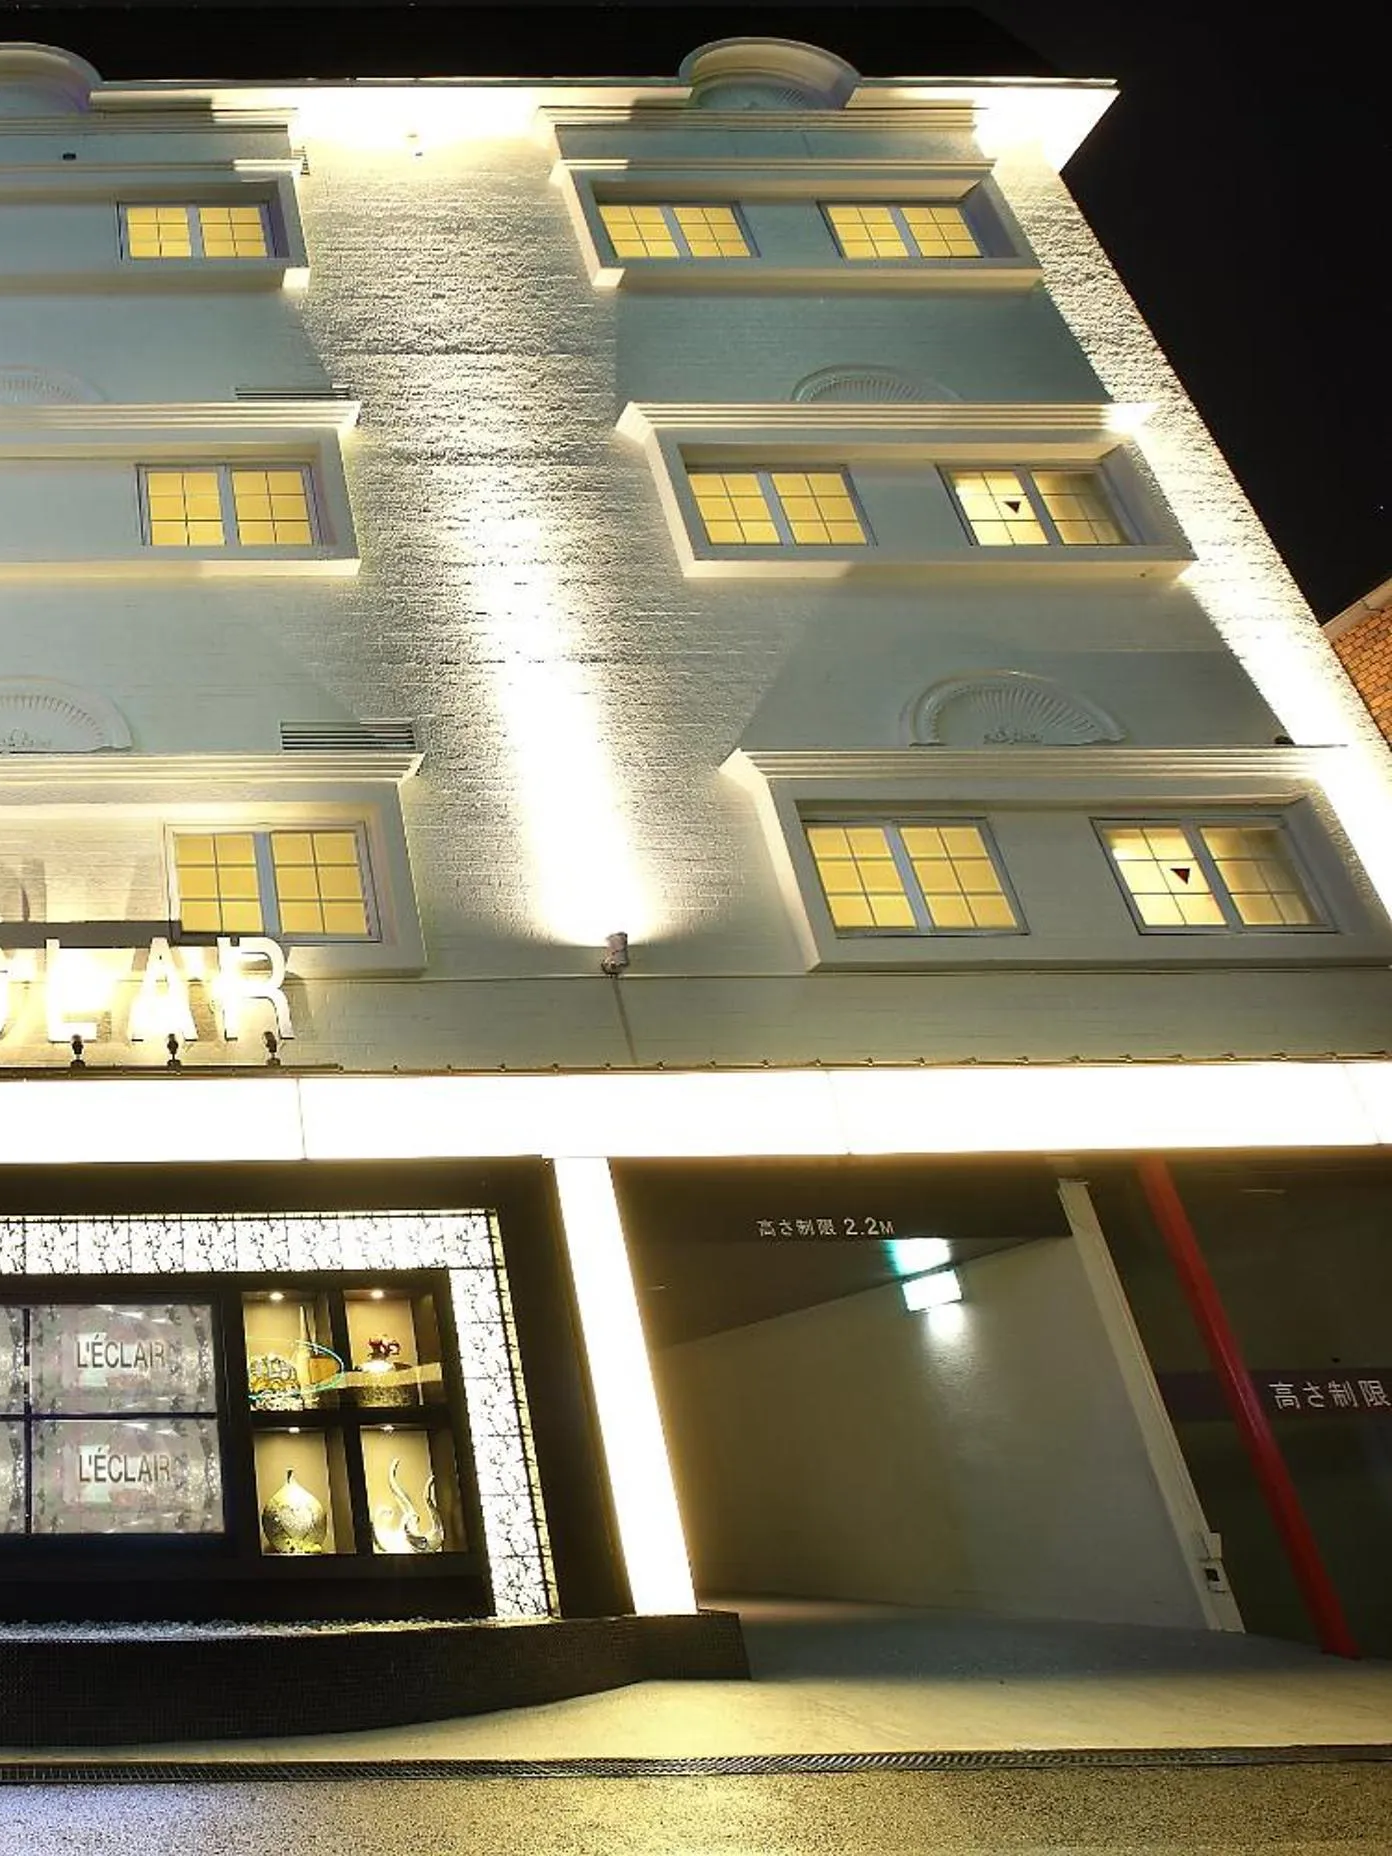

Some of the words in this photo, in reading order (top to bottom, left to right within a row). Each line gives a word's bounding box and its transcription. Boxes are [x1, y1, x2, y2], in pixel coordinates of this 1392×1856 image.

[756, 1218, 837, 1237] 高さ制限
[77, 1335, 166, 1369] L'ÉCLAIR
[1268, 1380, 1391, 1409] 高さ制限
[78, 1447, 171, 1483] L'ÉCLAIR
